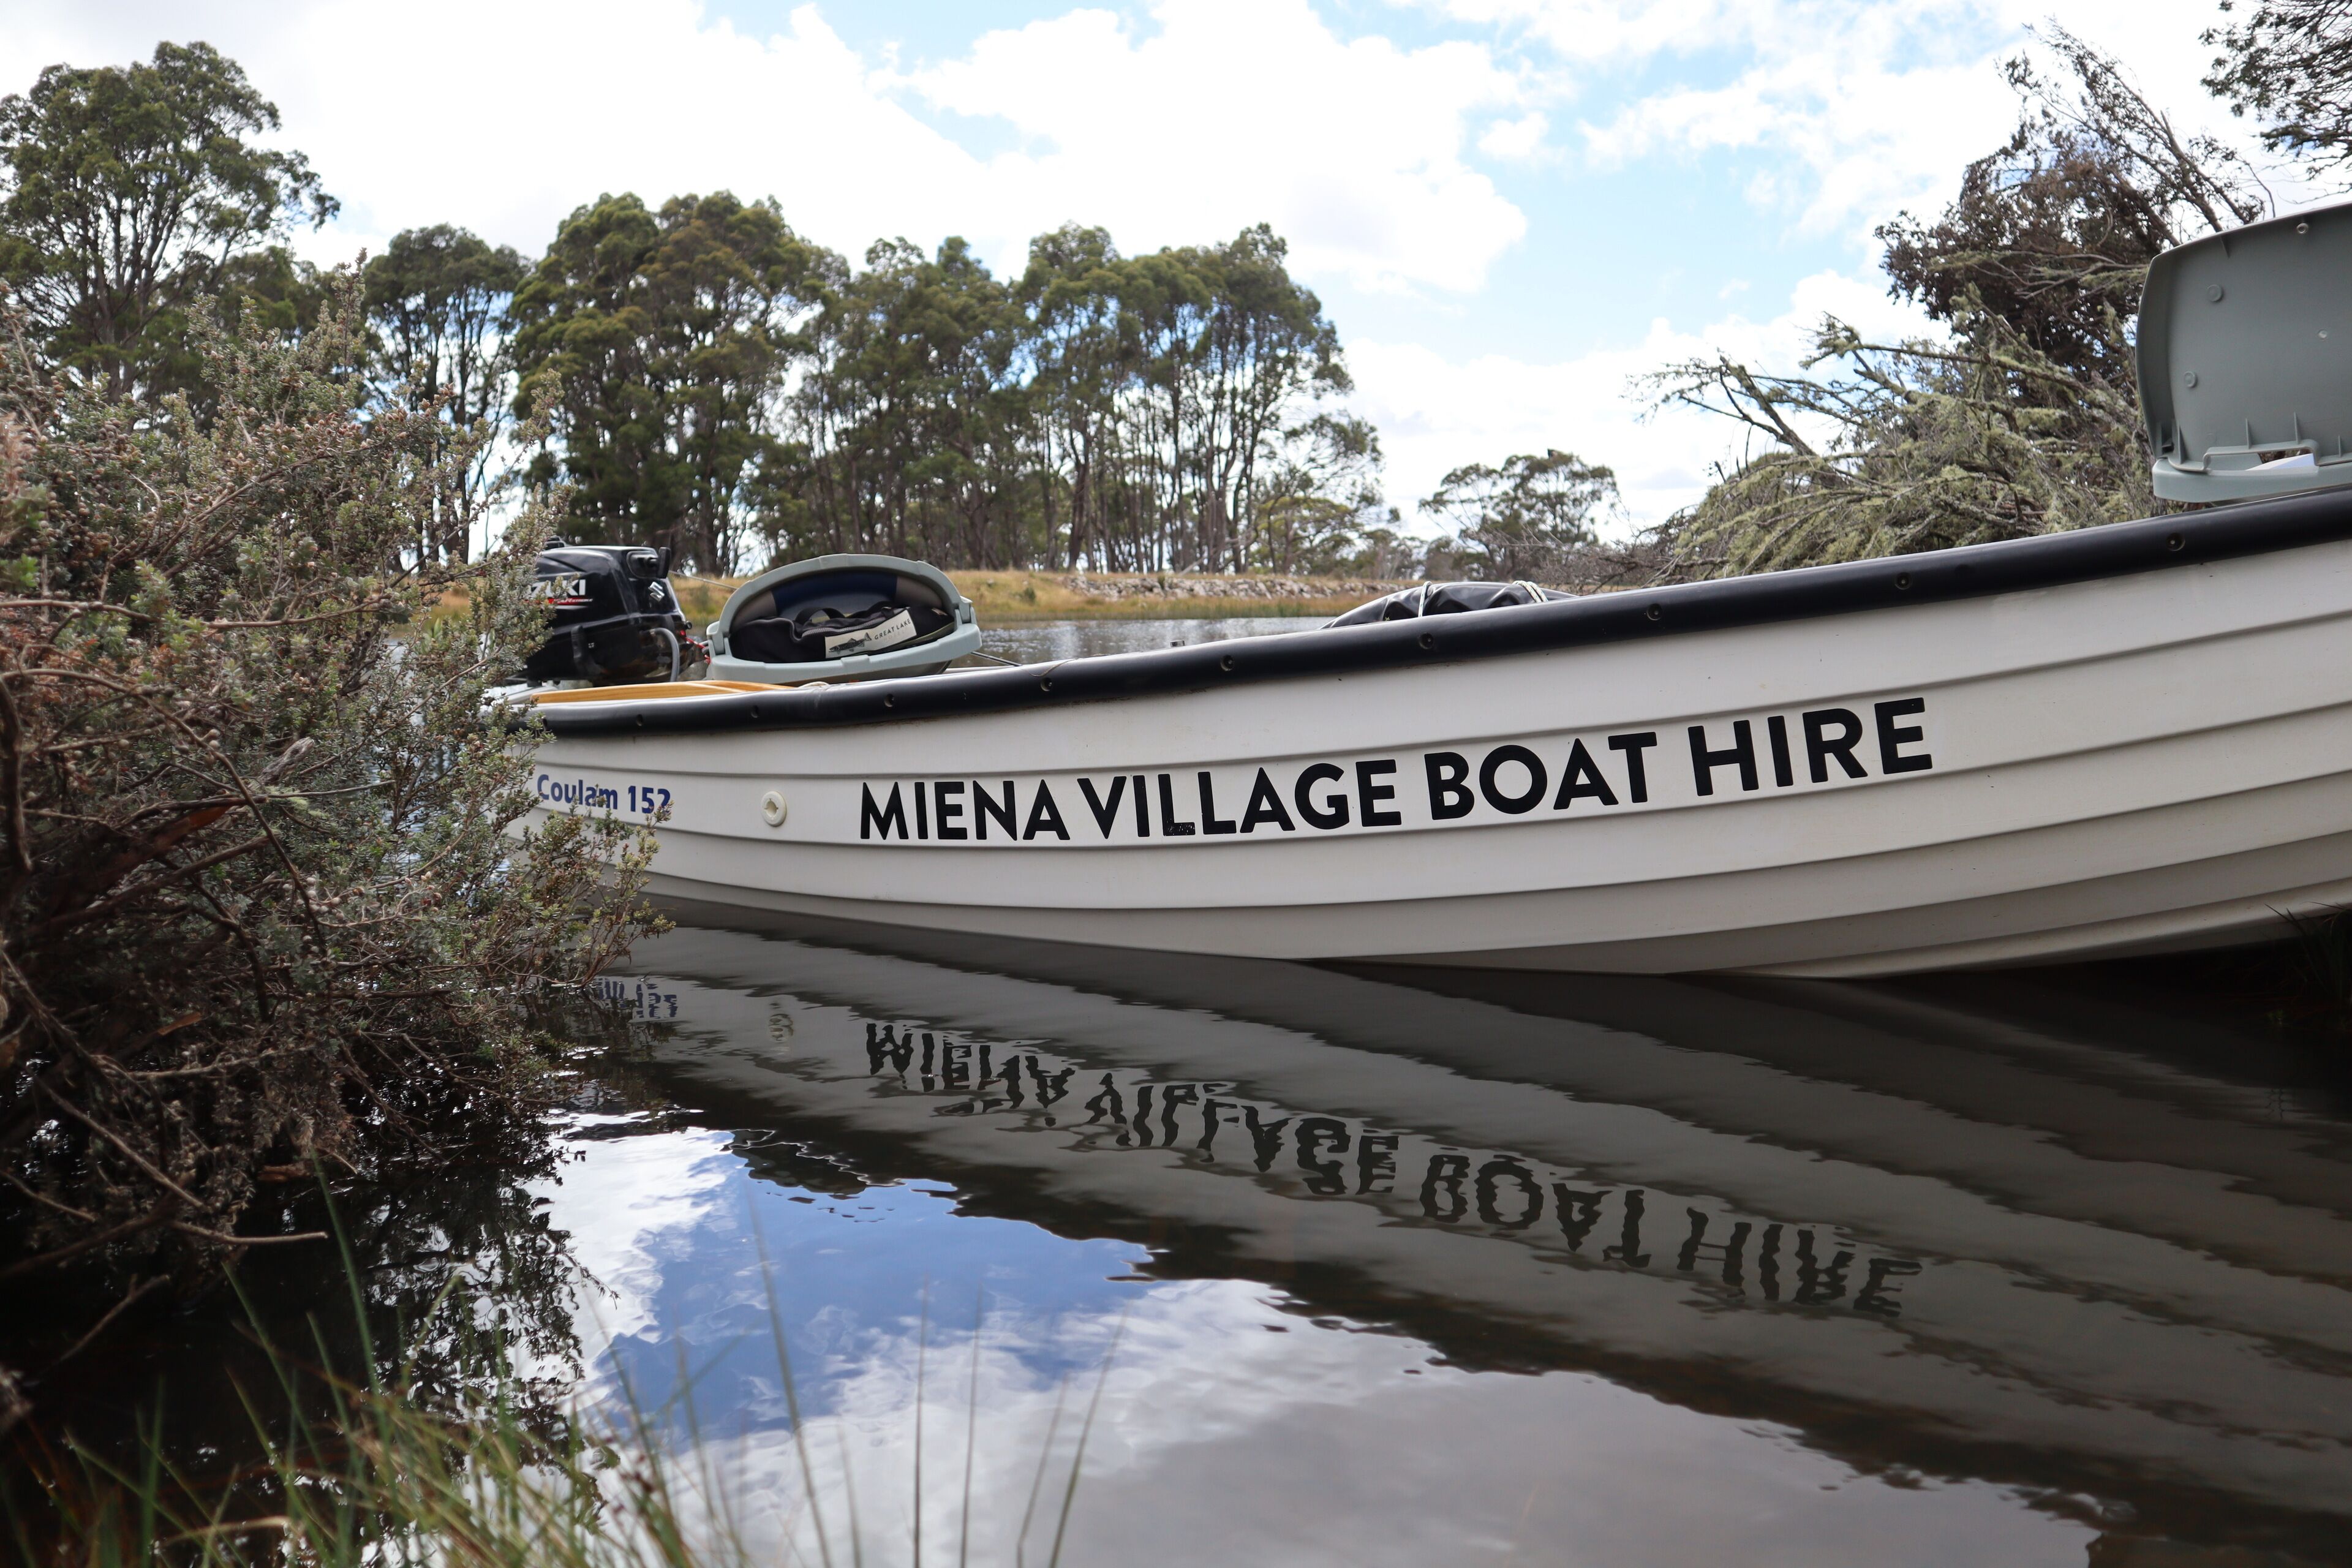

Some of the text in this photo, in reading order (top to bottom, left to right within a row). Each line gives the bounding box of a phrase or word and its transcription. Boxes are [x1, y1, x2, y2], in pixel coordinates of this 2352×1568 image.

[527, 579, 586, 597] ZUKI
[875, 627, 894, 639] GREAT
[896, 619, 911, 630] LAKE
[861, 698, 1933, 841] MIENA VILLAGE BOAT HIRE
[537, 774, 671, 817] Coulam 152
